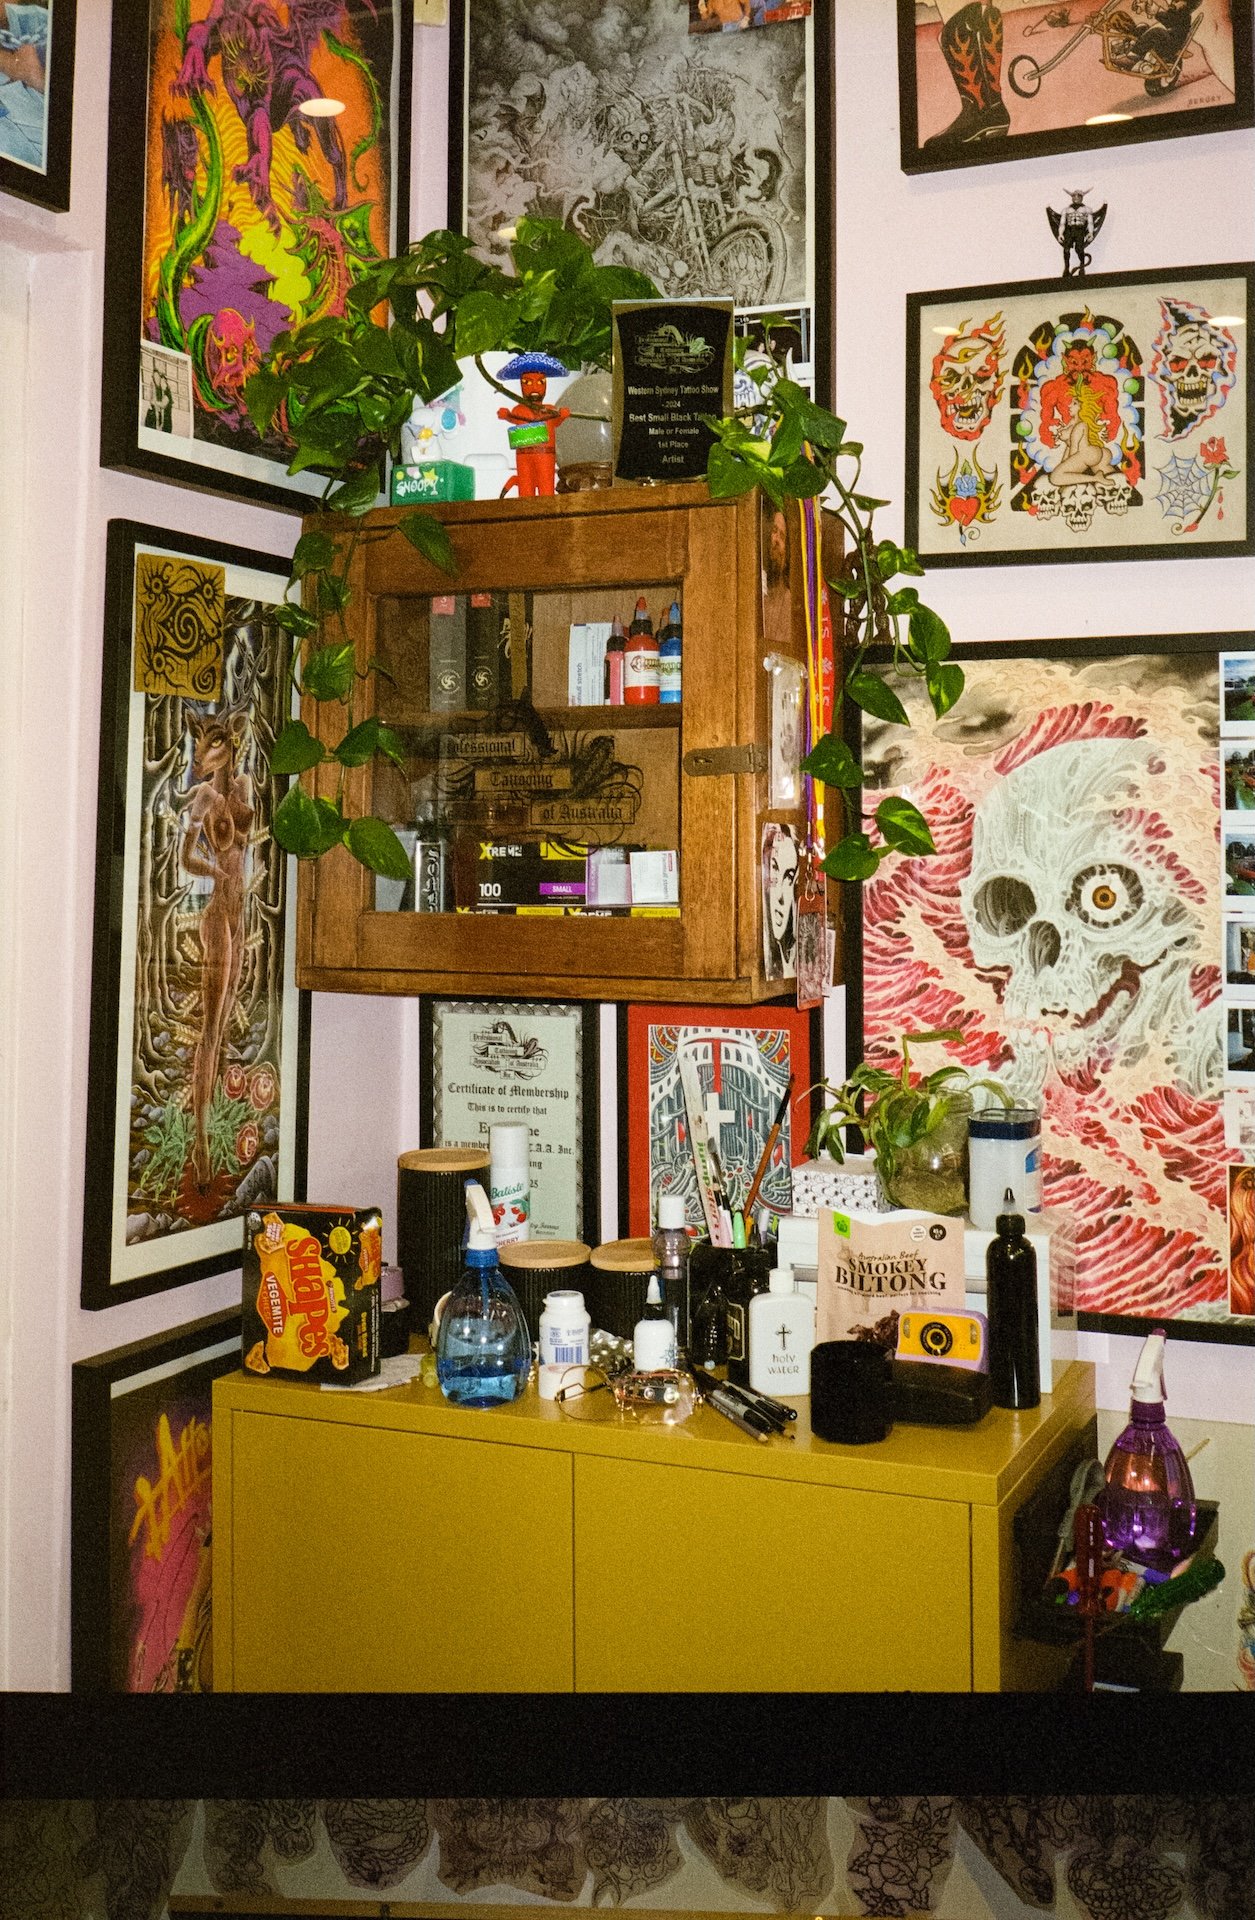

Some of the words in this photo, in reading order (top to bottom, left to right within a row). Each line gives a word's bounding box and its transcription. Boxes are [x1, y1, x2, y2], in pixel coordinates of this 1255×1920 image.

[627, 385, 653, 395] Western
[655, 385, 678, 396] Sydney
[679, 385, 700, 394] Tattoo
[701, 385, 719, 394] Show
[629, 413, 647, 422] Best
[648, 413, 669, 422] Small
[670, 412, 691, 422] Black
[648, 427, 664, 435] Male
[675, 426, 699, 435] Female
[658, 440, 668, 448] 1st
[669, 440, 689, 448] Place
[661, 454, 684, 463] Artist
[396, 479, 438, 496] SNOOPY
[559, 804, 622, 820] Australia
[479, 883, 502, 897] 100
[552, 885, 573, 893] SMALL
[448, 1082, 496, 1095] Certificate
[498, 1084, 507, 1096] of
[509, 1085, 569, 1100] Membership
[467, 1102, 486, 1112] This
[507, 1106, 531, 1114] certify
[532, 1106, 547, 1115] that
[557, 1145, 574, 1155] Inc.
[491, 1183, 523, 1199] Batiste
[858, 1252, 897, 1261] Australian
[900, 1249, 919, 1260] Beef
[849, 1258, 928, 1275] SMOKEY
[835, 1265, 946, 1293] BILTONG
[265, 1275, 283, 1334] VEGEMITE
[772, 1353, 796, 1363] holy
